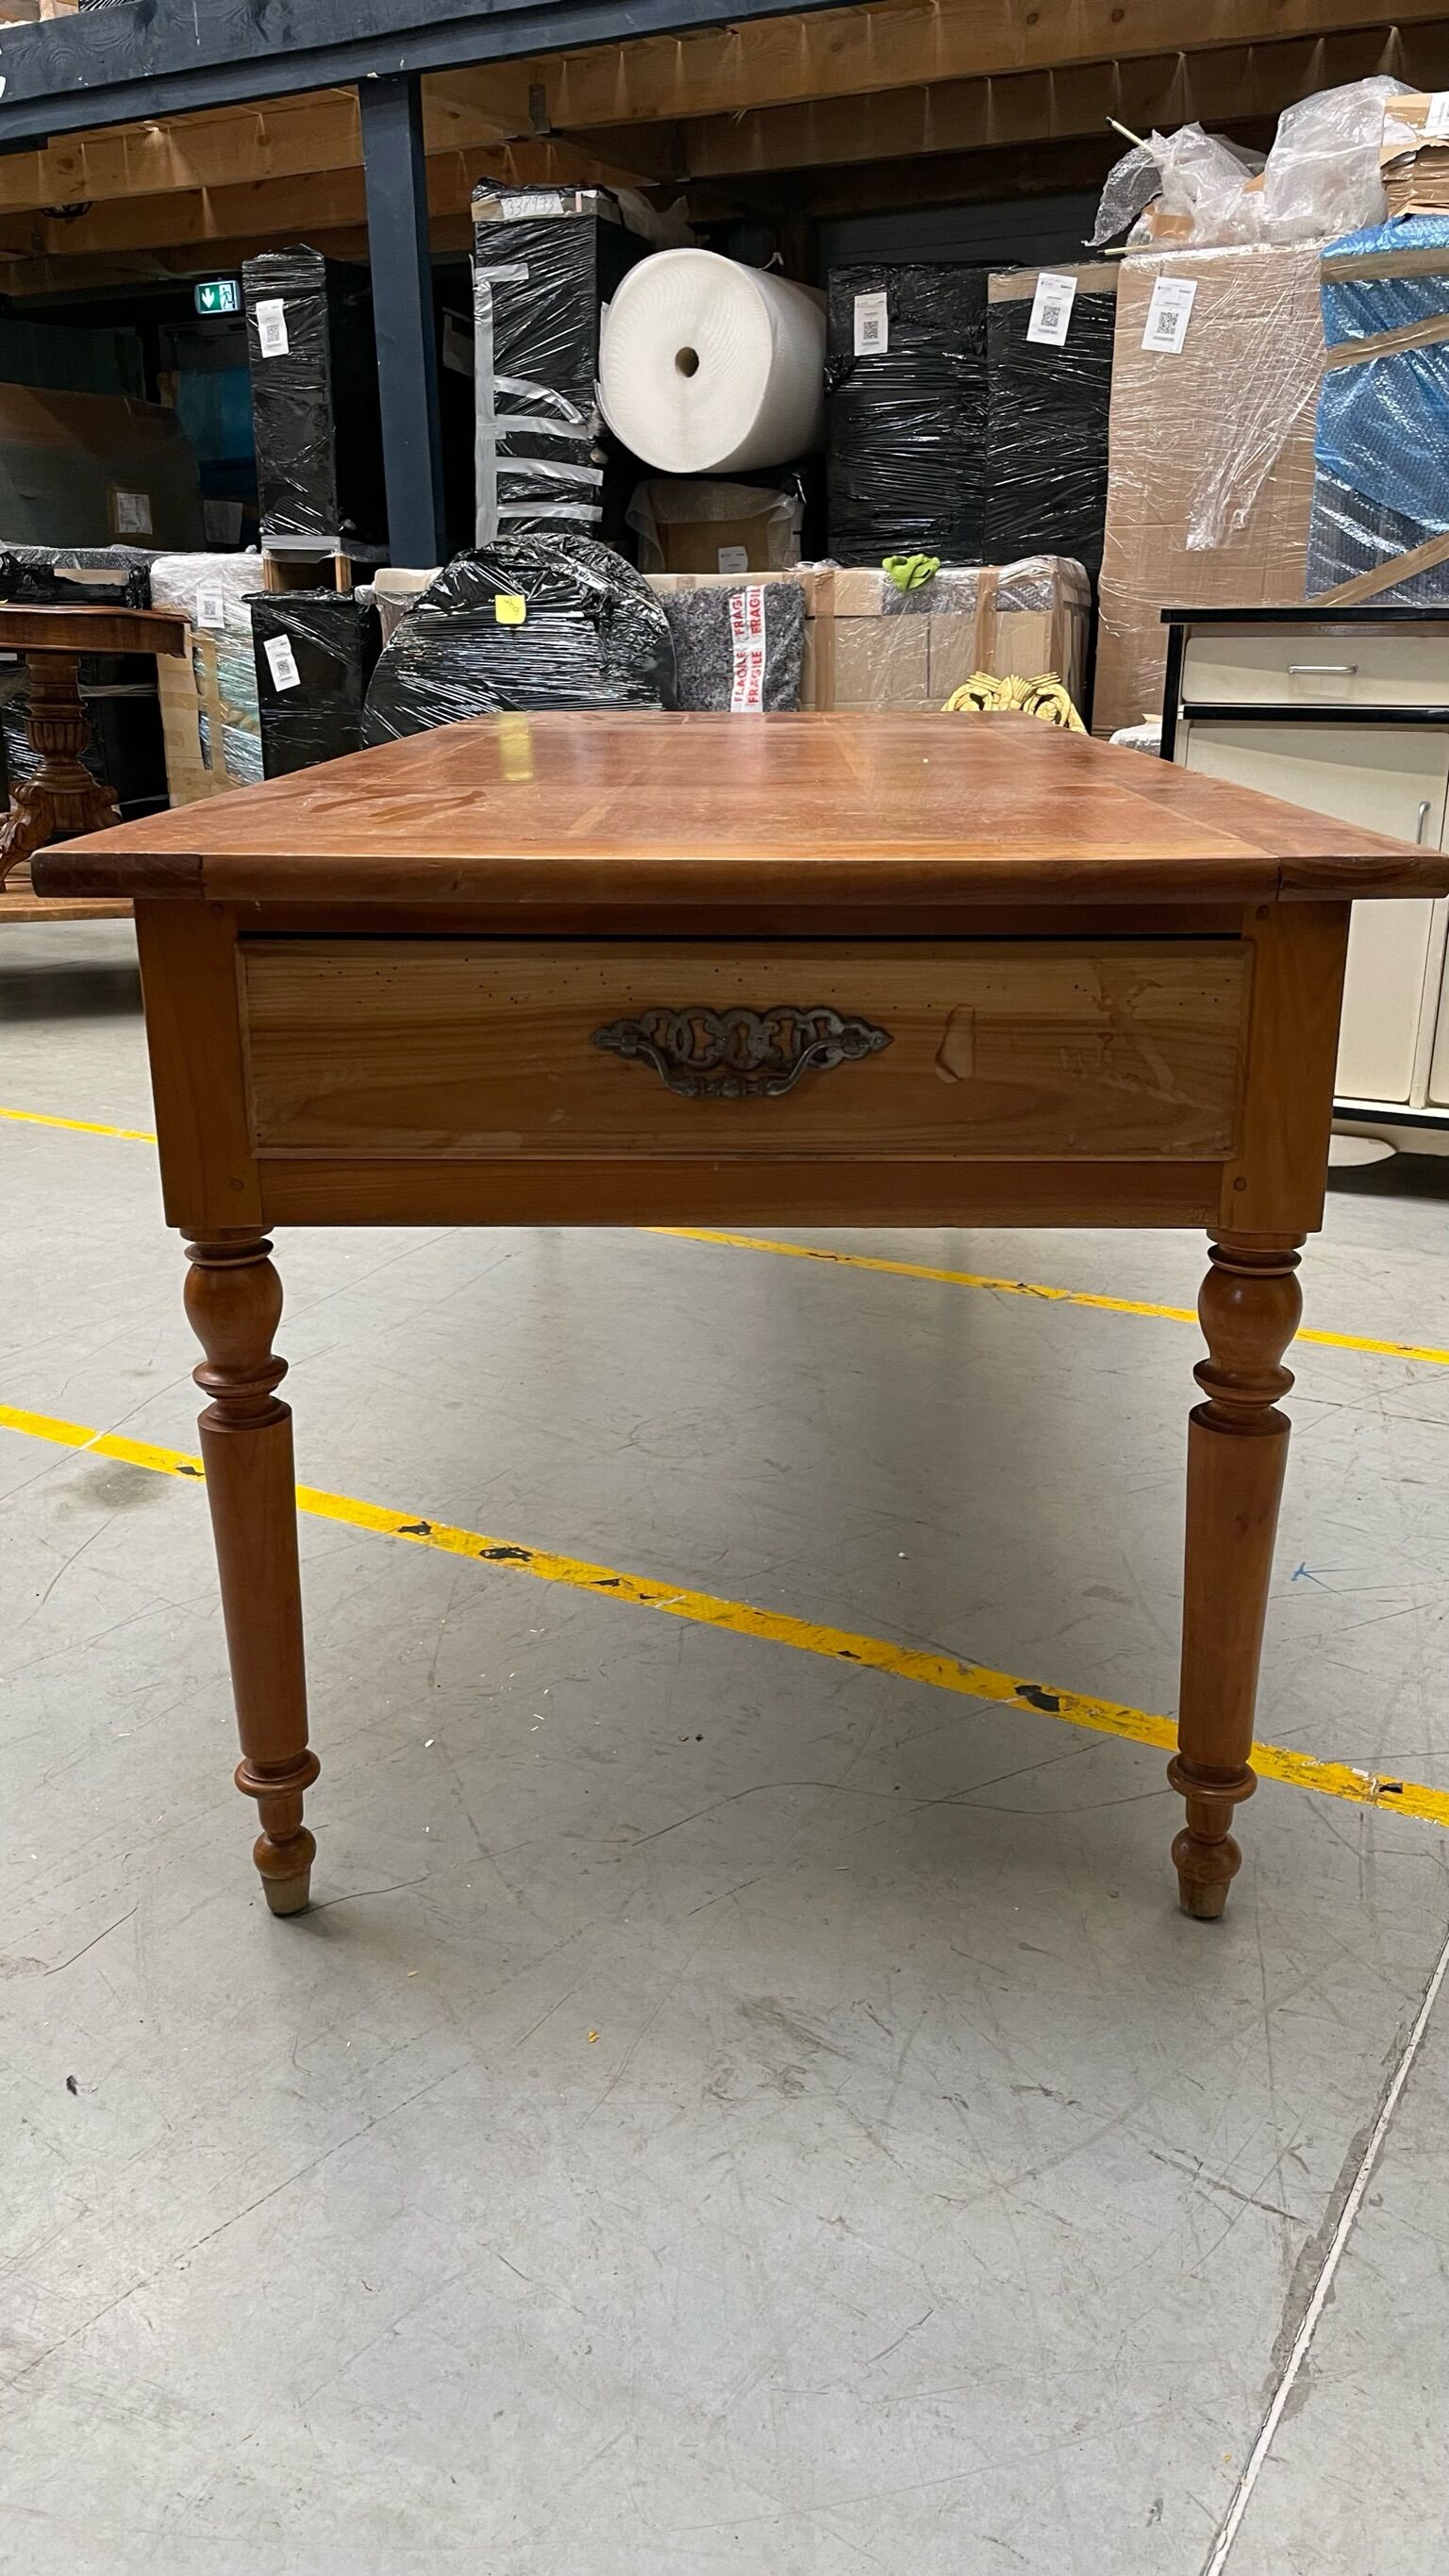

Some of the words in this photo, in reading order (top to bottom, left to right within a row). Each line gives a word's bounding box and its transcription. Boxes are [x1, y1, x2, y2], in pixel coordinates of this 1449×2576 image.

[732, 594, 745, 635] FRAGI
[749, 589, 761, 634] FRAGIL
[748, 651, 762, 703] FRAGILE
